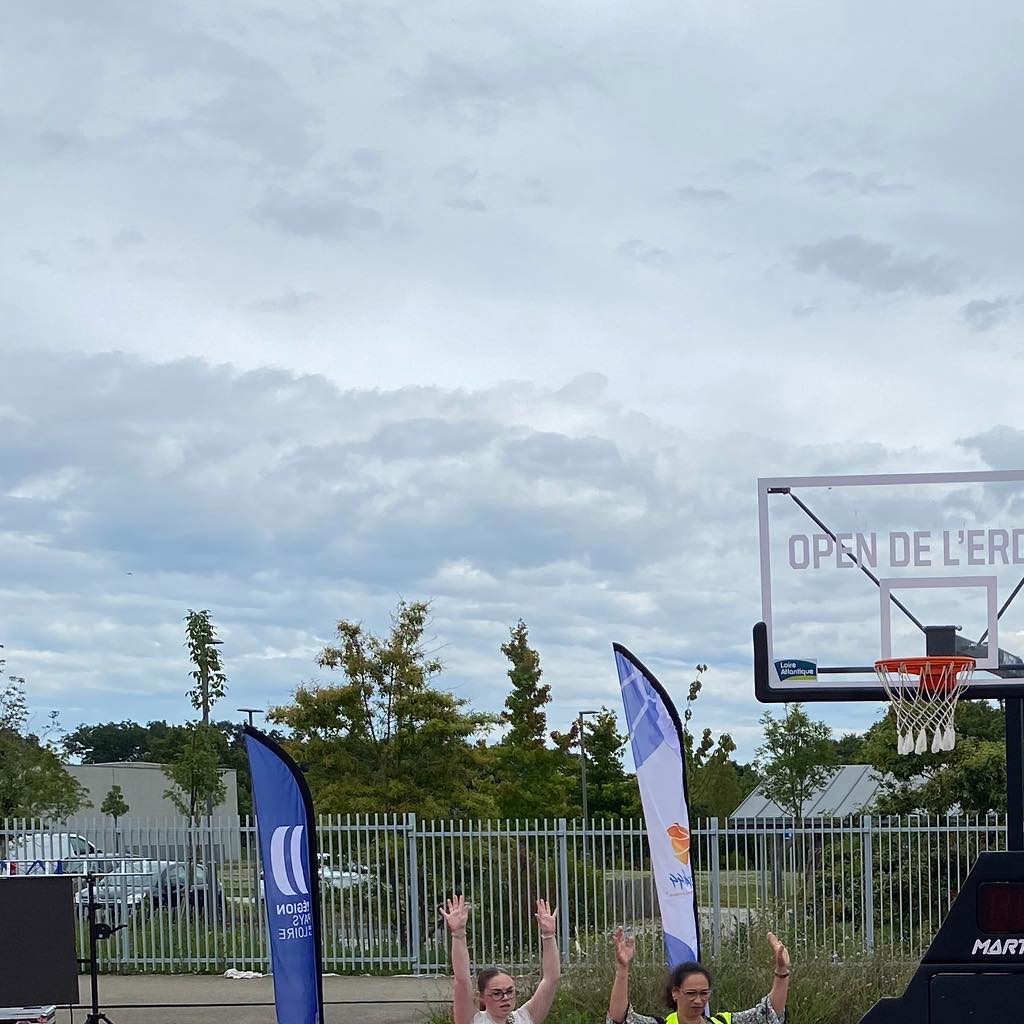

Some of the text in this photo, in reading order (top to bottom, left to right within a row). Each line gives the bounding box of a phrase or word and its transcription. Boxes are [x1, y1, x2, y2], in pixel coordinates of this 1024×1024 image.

[788, 531, 878, 570] OPEN
[889, 530, 932, 568] DE
[780, 661, 797, 669] Loire
